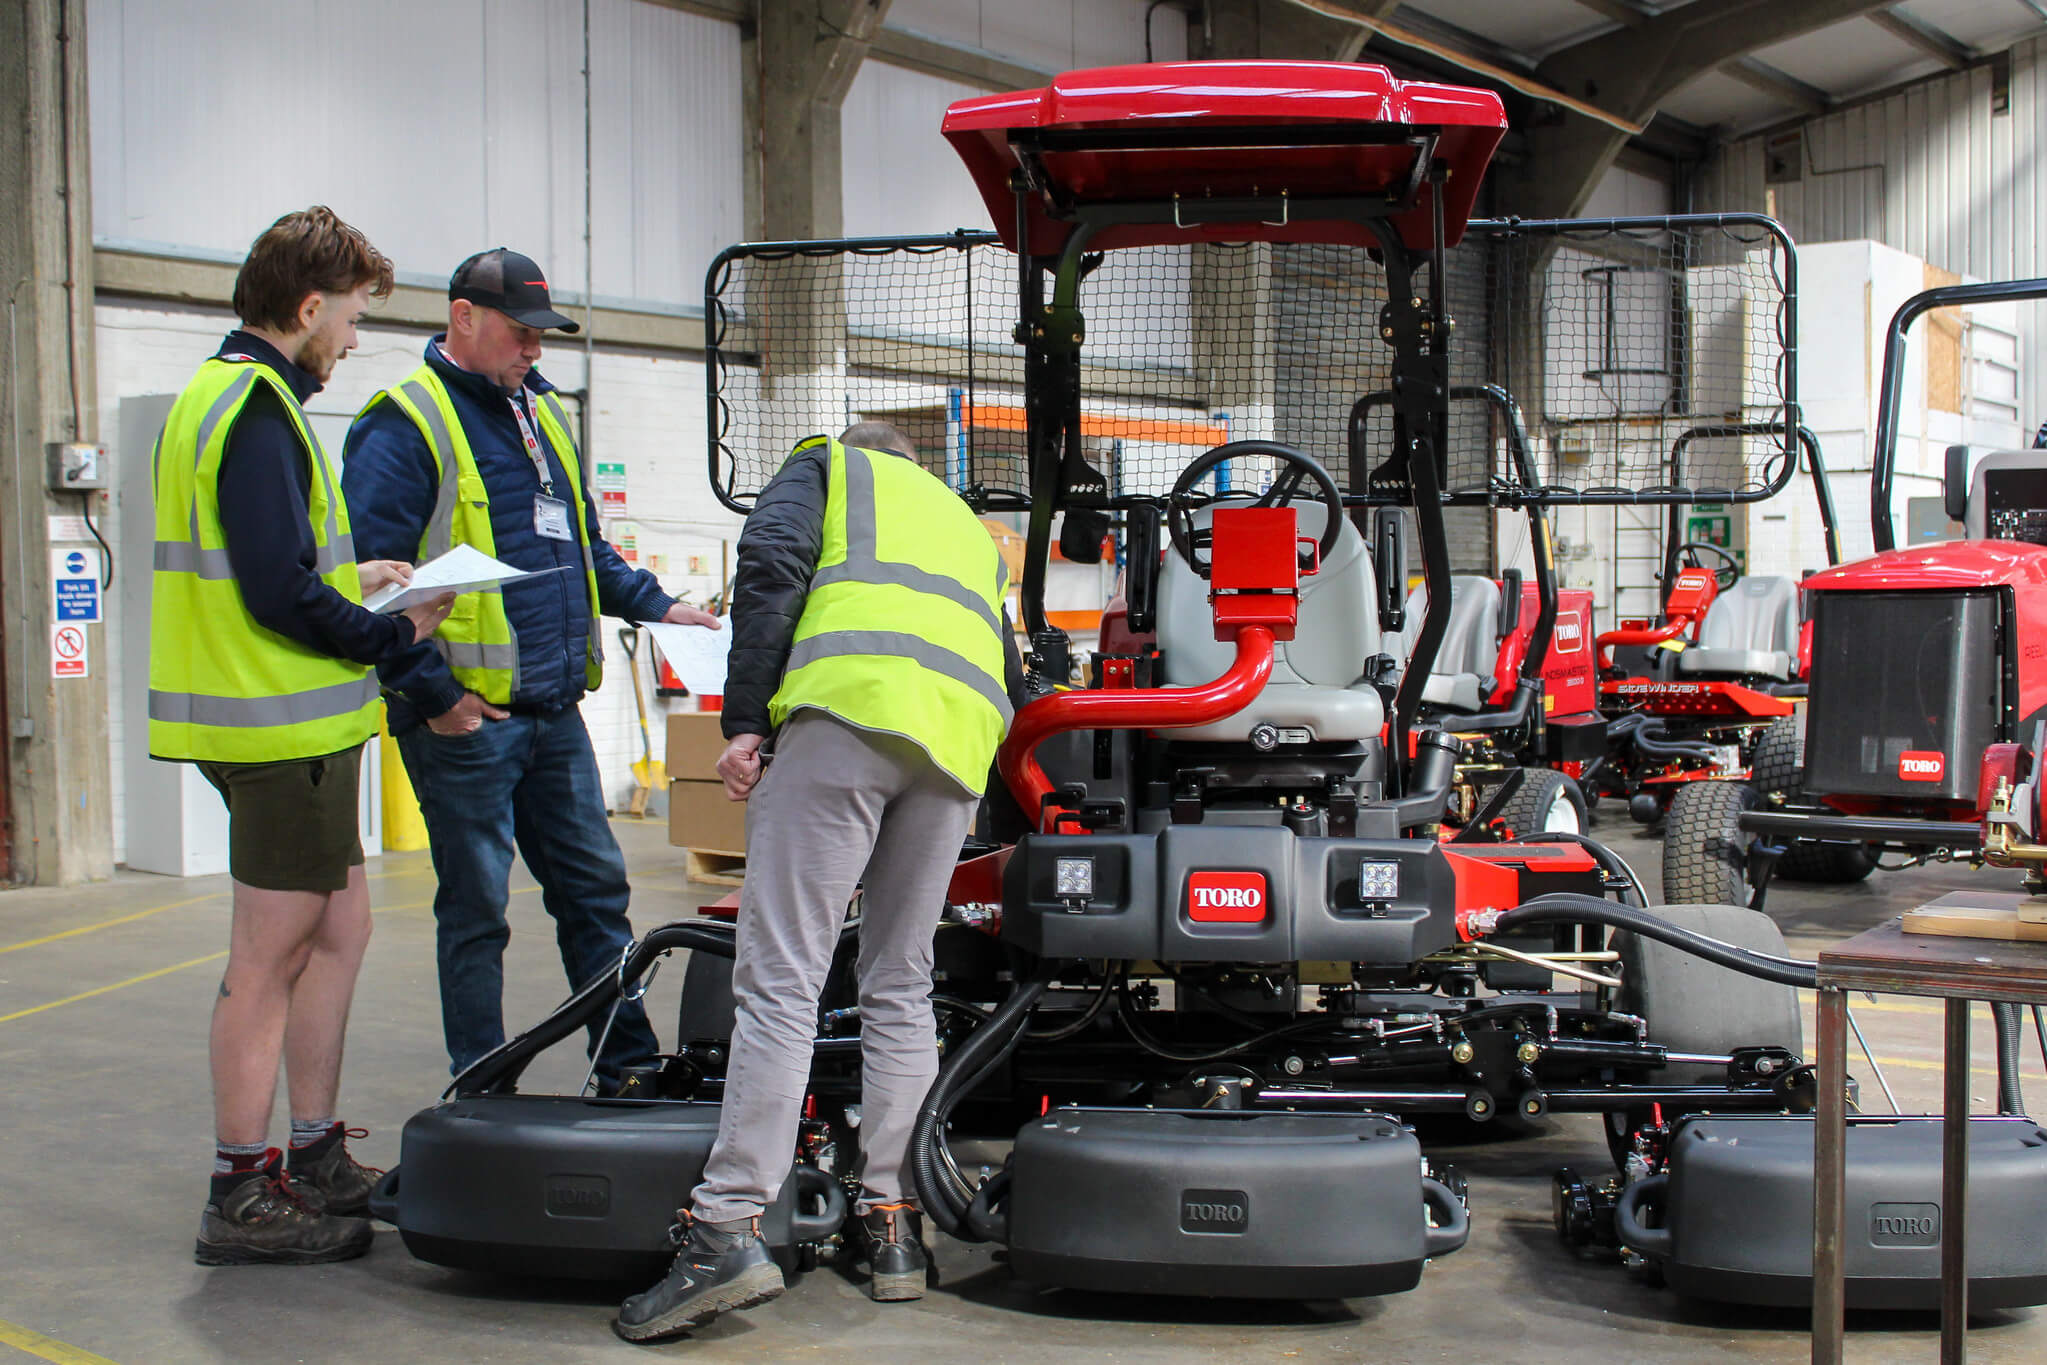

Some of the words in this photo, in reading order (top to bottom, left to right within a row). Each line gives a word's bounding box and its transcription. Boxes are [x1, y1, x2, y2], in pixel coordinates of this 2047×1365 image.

[1557, 623, 1580, 641] TORO
[1618, 683, 1700, 694] SIDEWINDER
[1901, 759, 1941, 773] TORO
[1194, 887, 1261, 908] TORO
[1185, 1203, 1243, 1222] TORO
[1875, 1217, 1934, 1235] TORO
